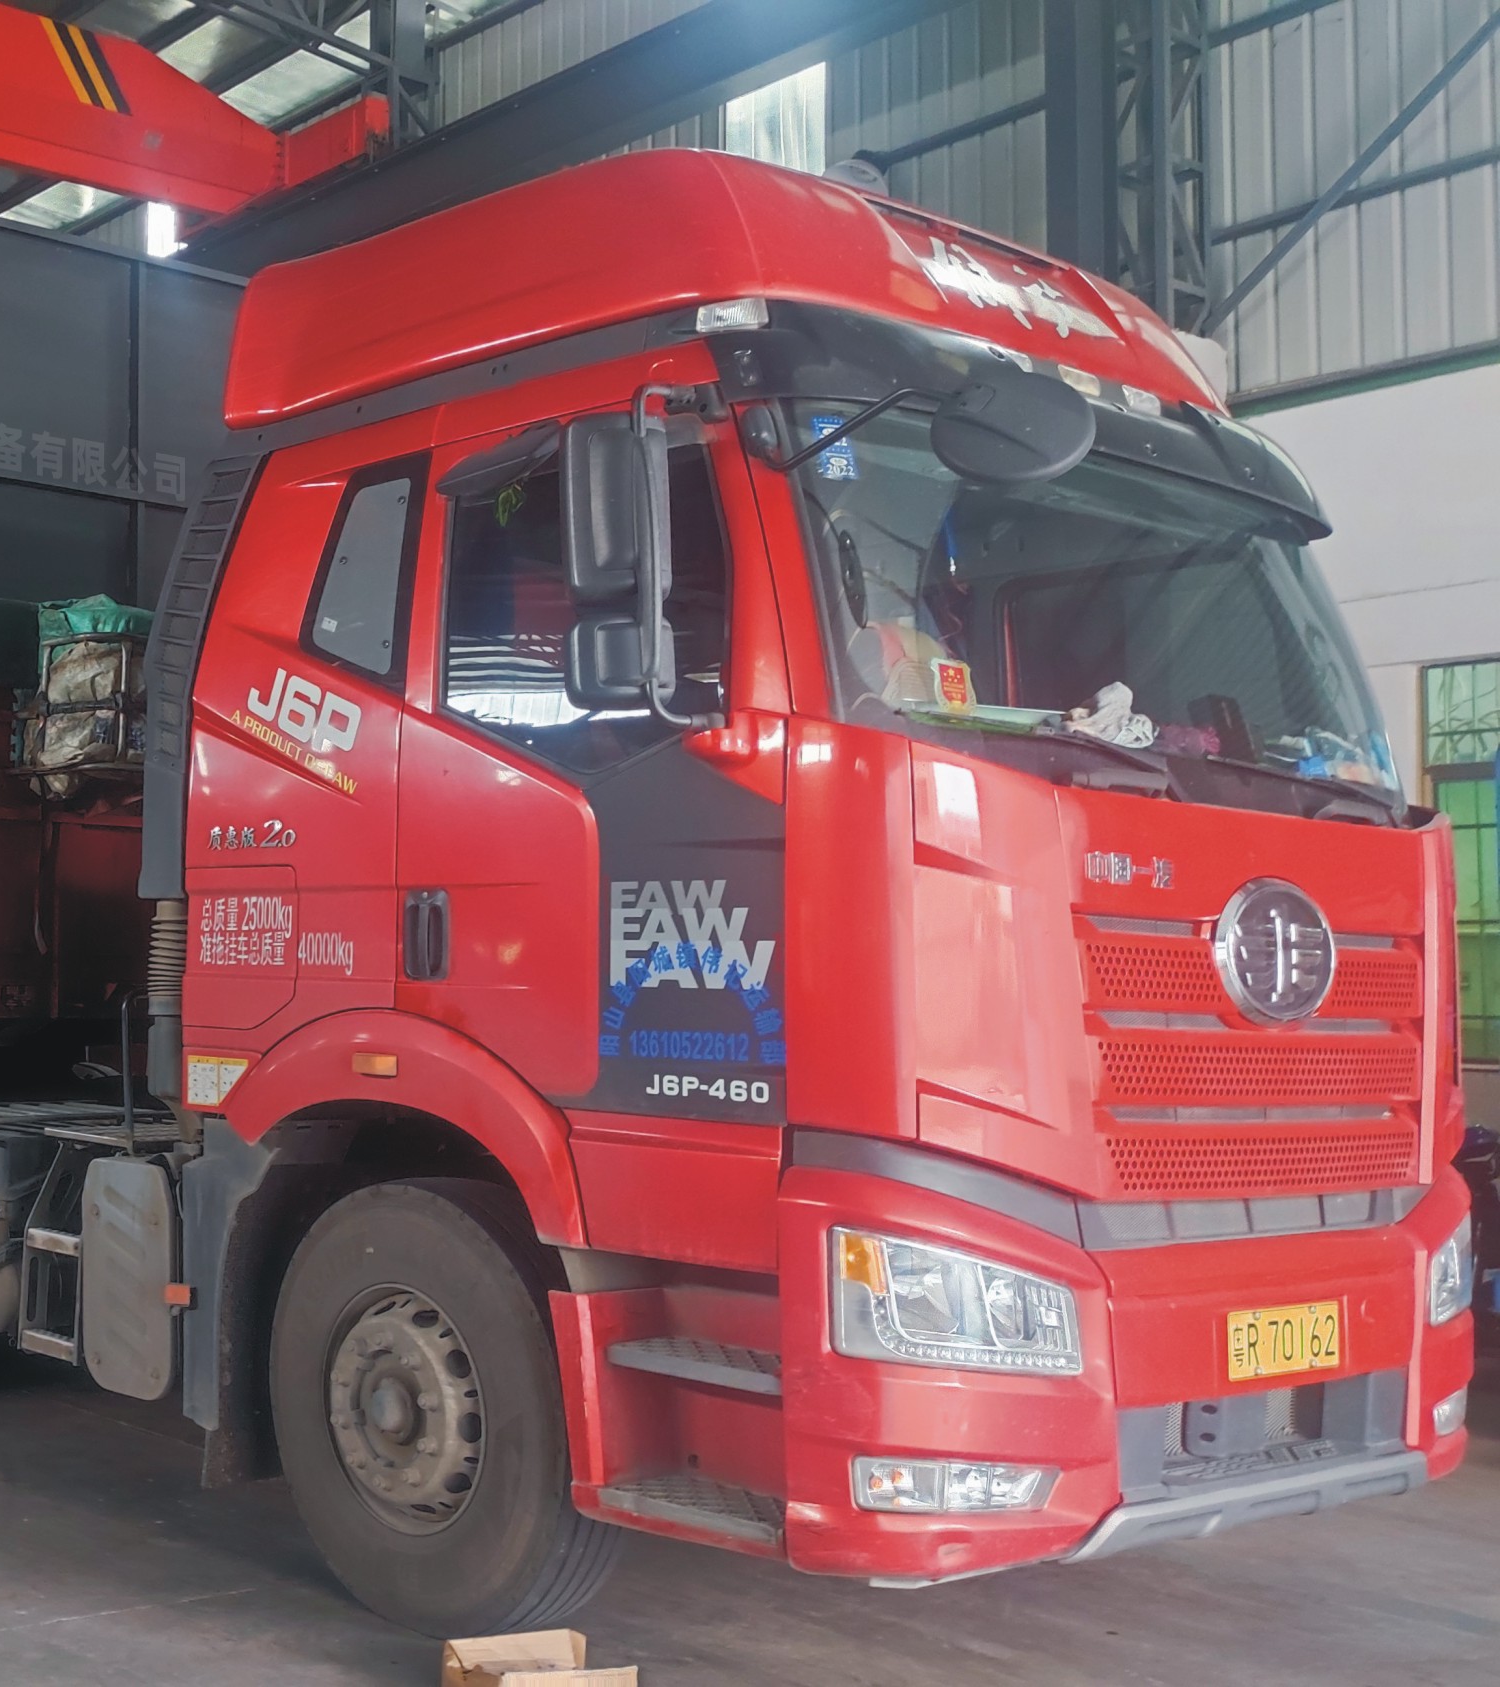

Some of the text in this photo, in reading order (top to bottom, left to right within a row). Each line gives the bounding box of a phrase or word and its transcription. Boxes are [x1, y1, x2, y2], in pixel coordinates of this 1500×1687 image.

[247, 667, 362, 752] J6P
[230, 709, 241, 725] A
[243, 715, 302, 761] PRODUCT
[207, 819, 297, 850] 质惠版 2.0
[200, 896, 293, 938] 总质量 25000kg
[200, 932, 354, 975] 准拖挂车总质量 40000kg
[629, 1030, 748, 1062] 13610522612
[645, 1074, 770, 1104] J6P-460
